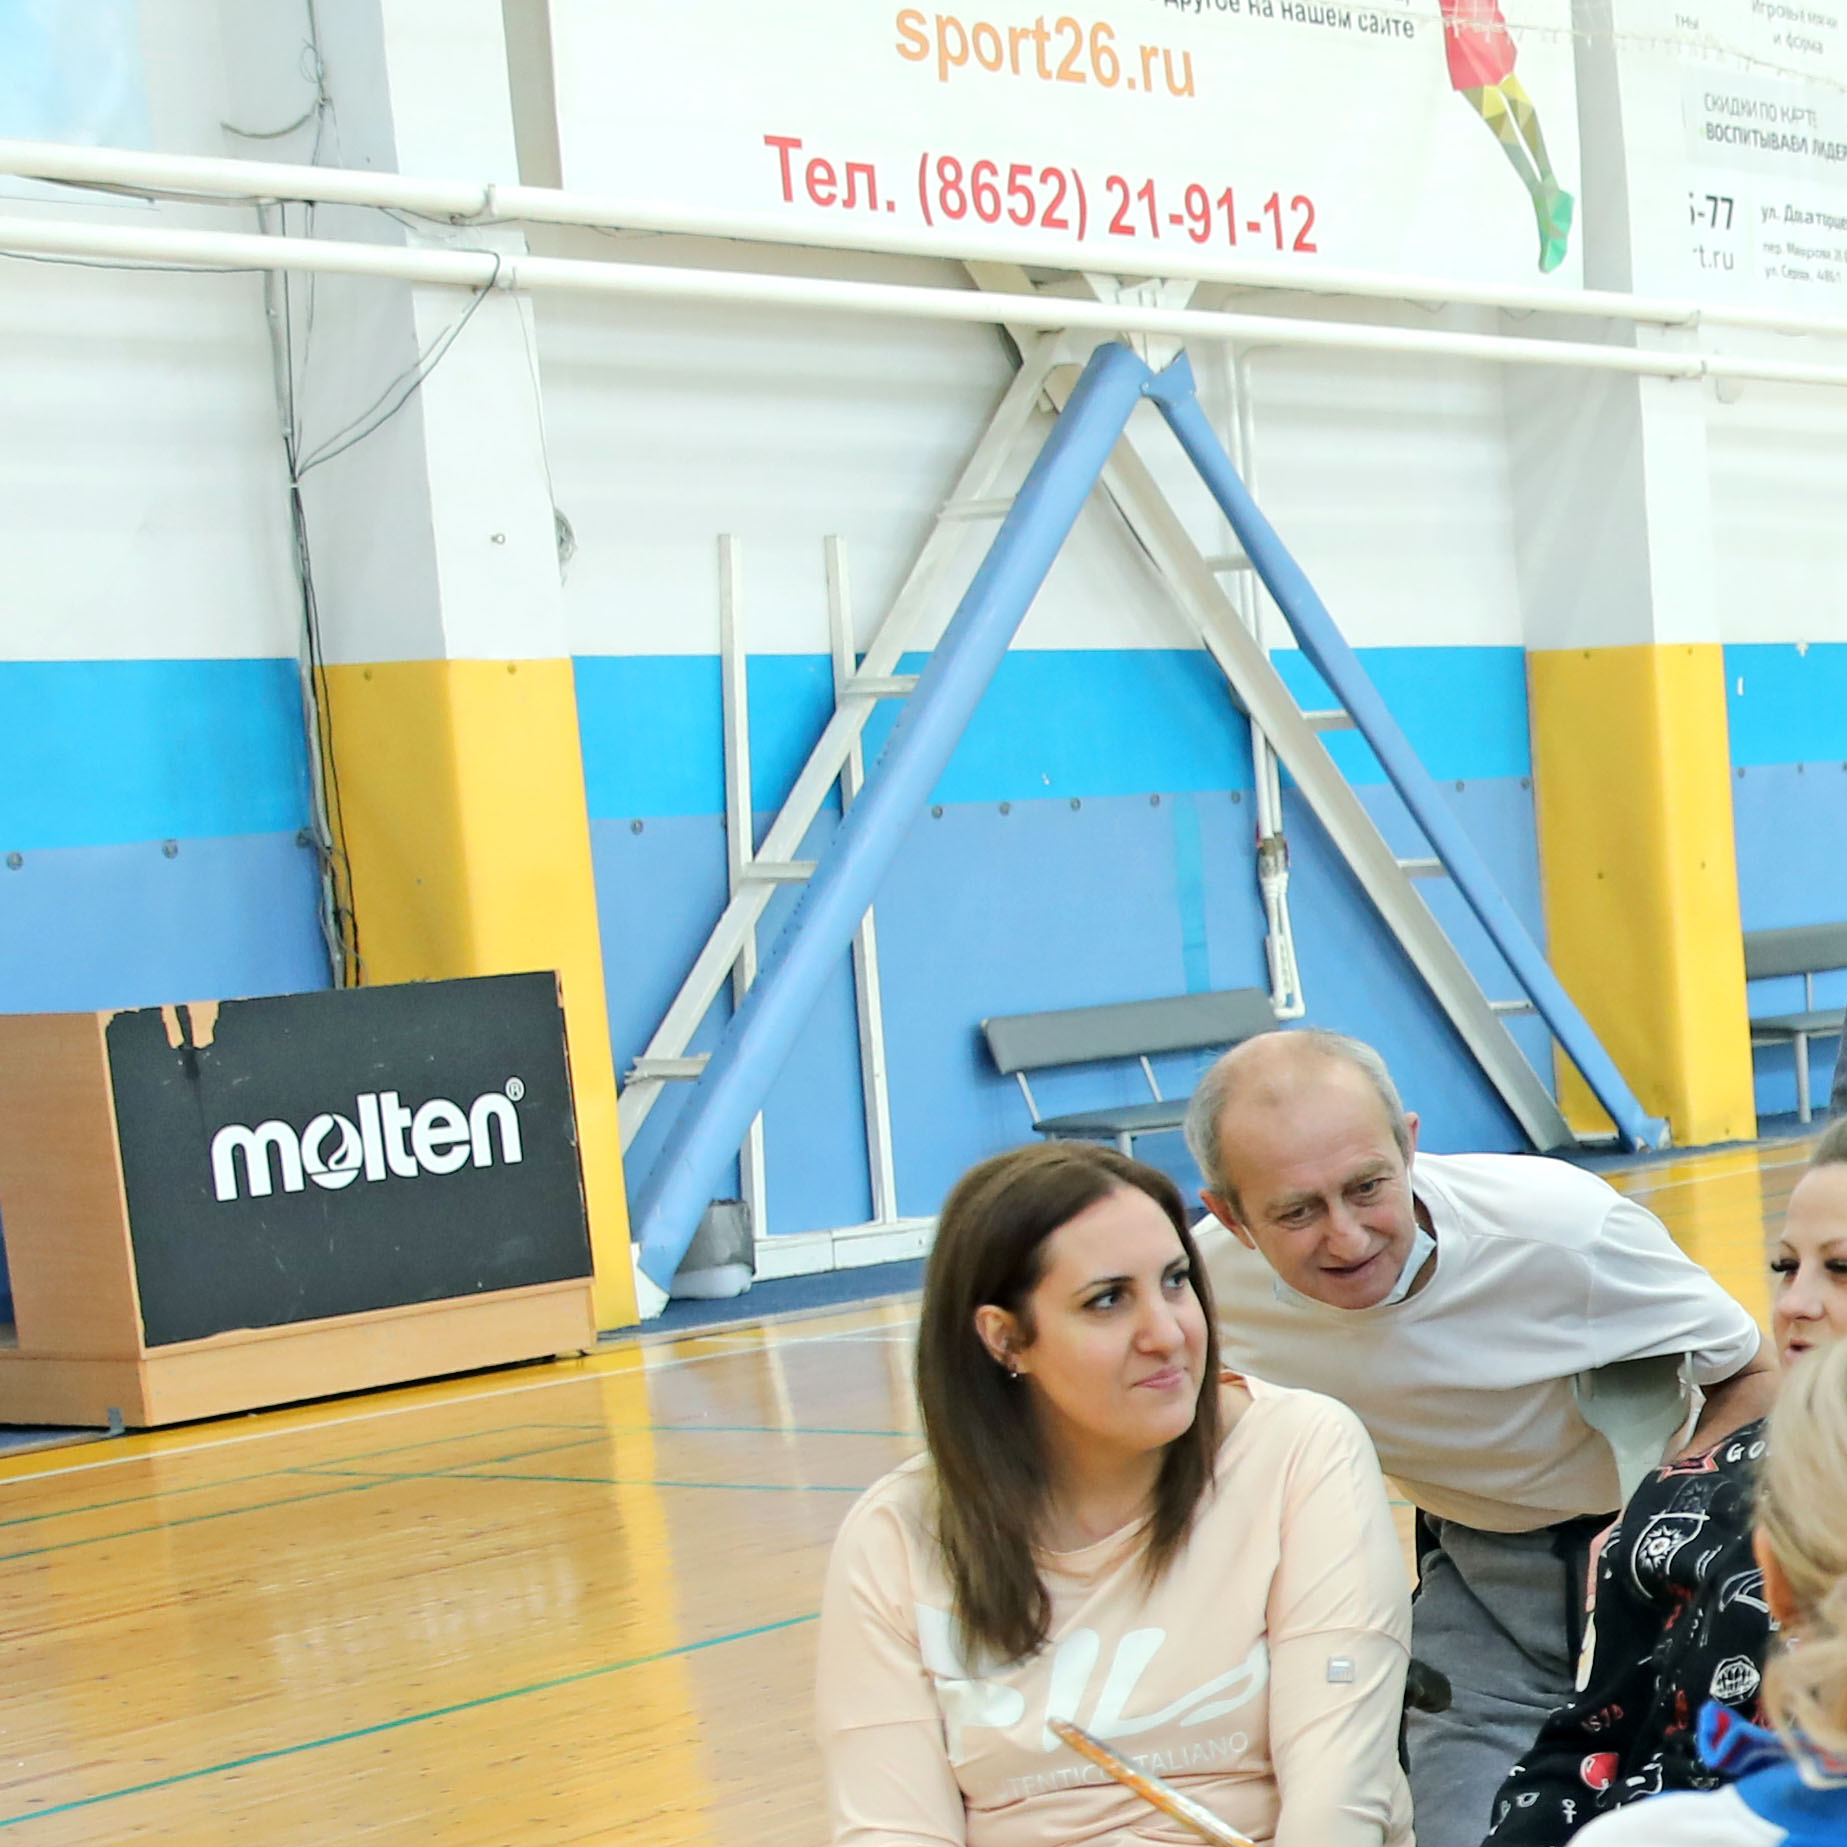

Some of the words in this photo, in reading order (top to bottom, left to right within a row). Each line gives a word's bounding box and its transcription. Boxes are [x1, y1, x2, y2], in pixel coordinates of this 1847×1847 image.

[1281, 3, 1351, 30] нашем
[895, 8, 1196, 98] sport26.ru
[763, 134, 897, 214] Тел.
[917, 152, 1089, 241] (8652)
[1107, 175, 1318, 254] 21-91-12
[1692, 244, 1735, 270] t.ru
[1132, 1730, 1250, 1772] TALIANO
